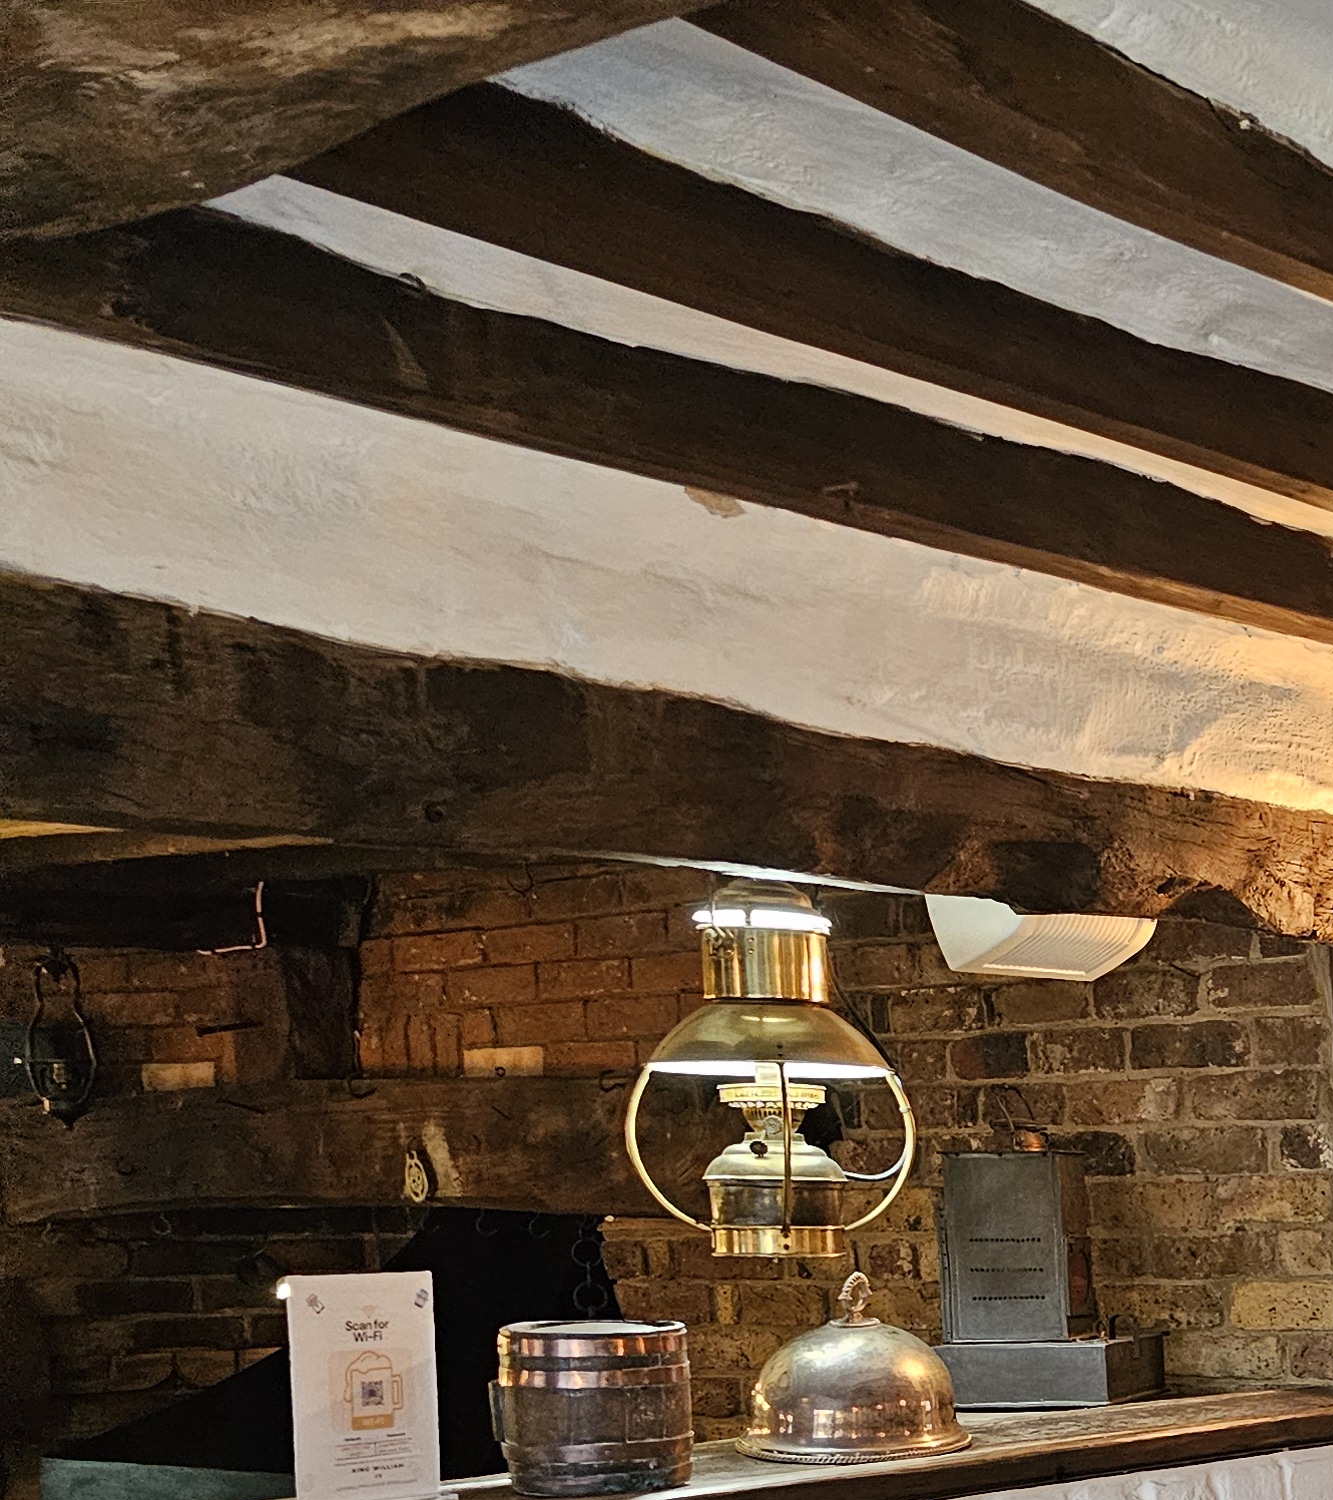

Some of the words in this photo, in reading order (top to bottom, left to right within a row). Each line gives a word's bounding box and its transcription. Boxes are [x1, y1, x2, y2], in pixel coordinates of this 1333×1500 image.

[345, 1321, 372, 1331] Scan
[373, 1319, 389, 1329] for
[353, 1330, 383, 1342] Wi-Fi
